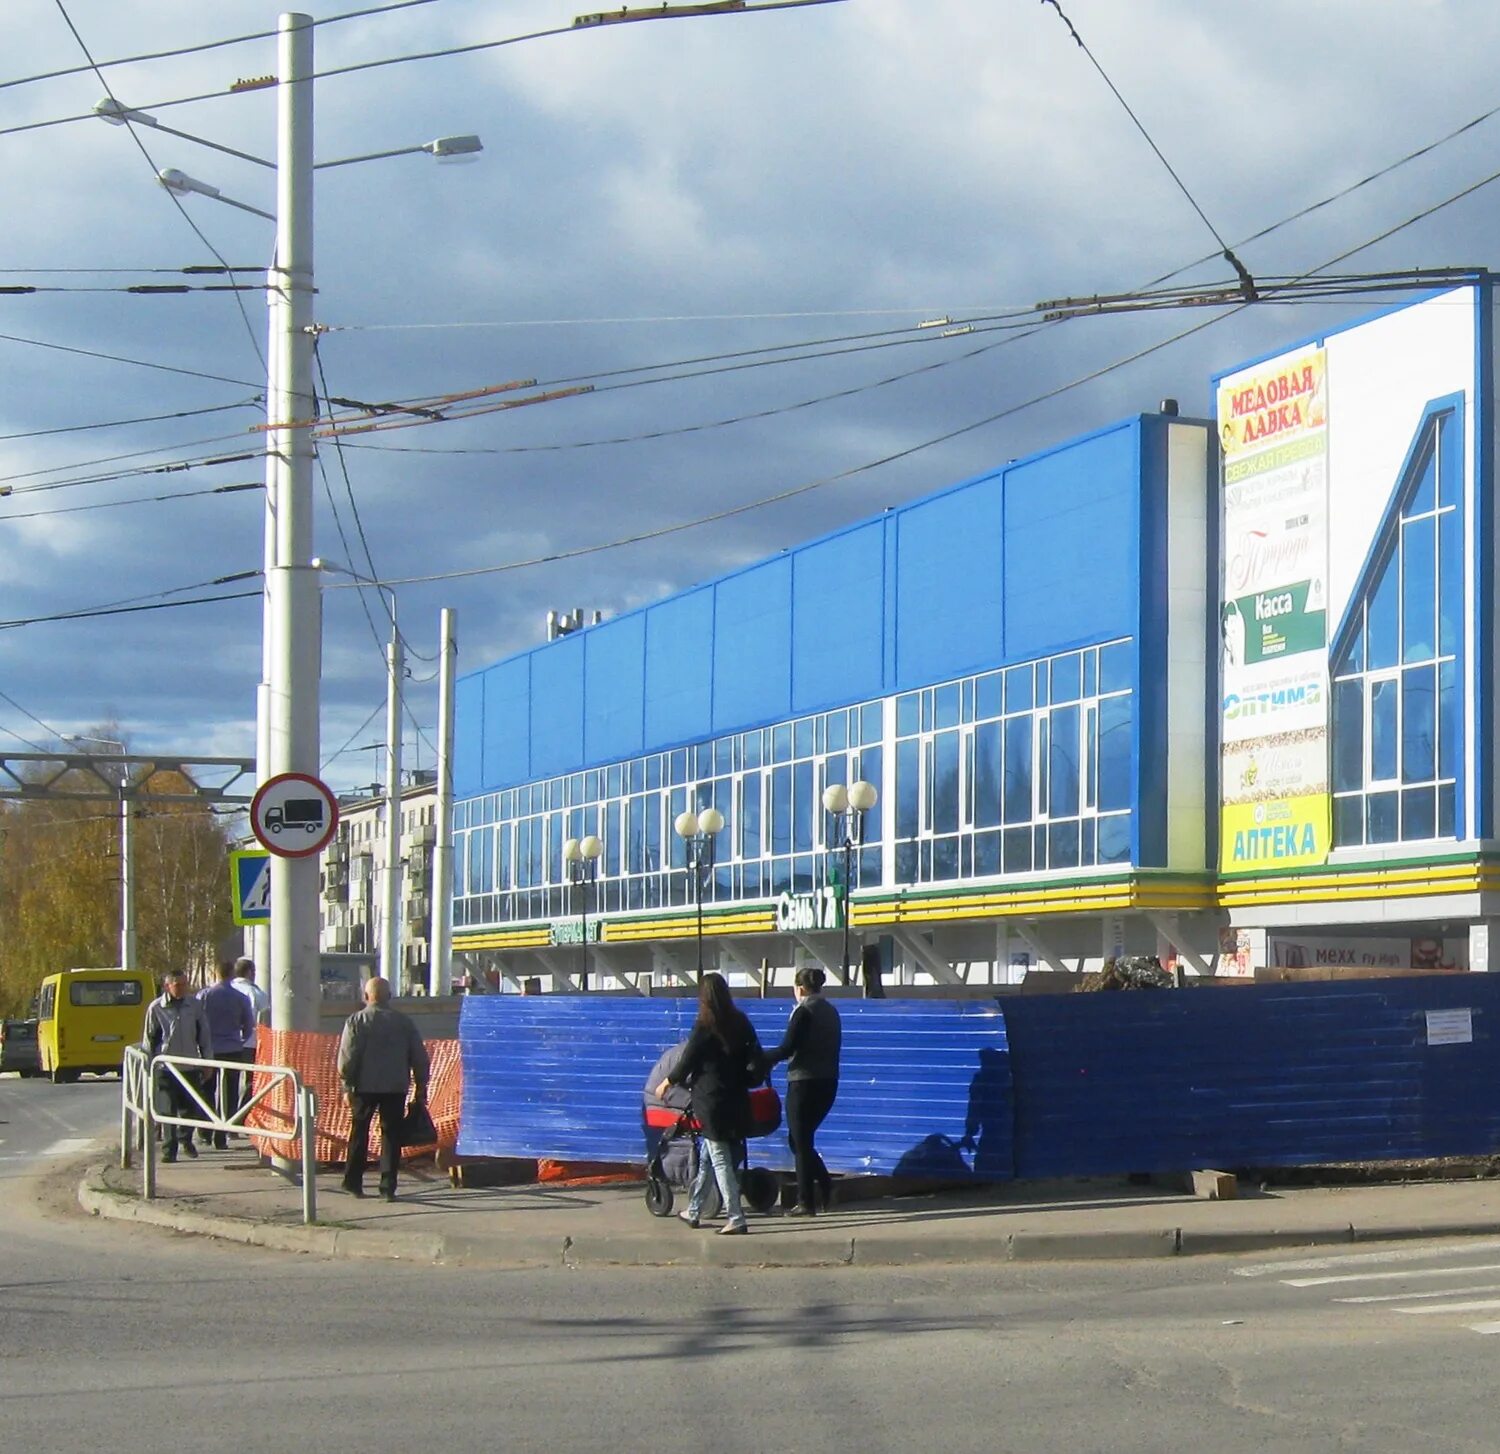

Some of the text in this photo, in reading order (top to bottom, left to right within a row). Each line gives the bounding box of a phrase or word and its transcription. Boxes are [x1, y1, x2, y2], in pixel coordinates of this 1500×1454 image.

[1231, 366, 1313, 418] МЕДОВАЯ
[1242, 402, 1302, 444] ЛАВКА
[1255, 592, 1292, 620] Касса
[1232, 822, 1316, 862] АПТЕКА
